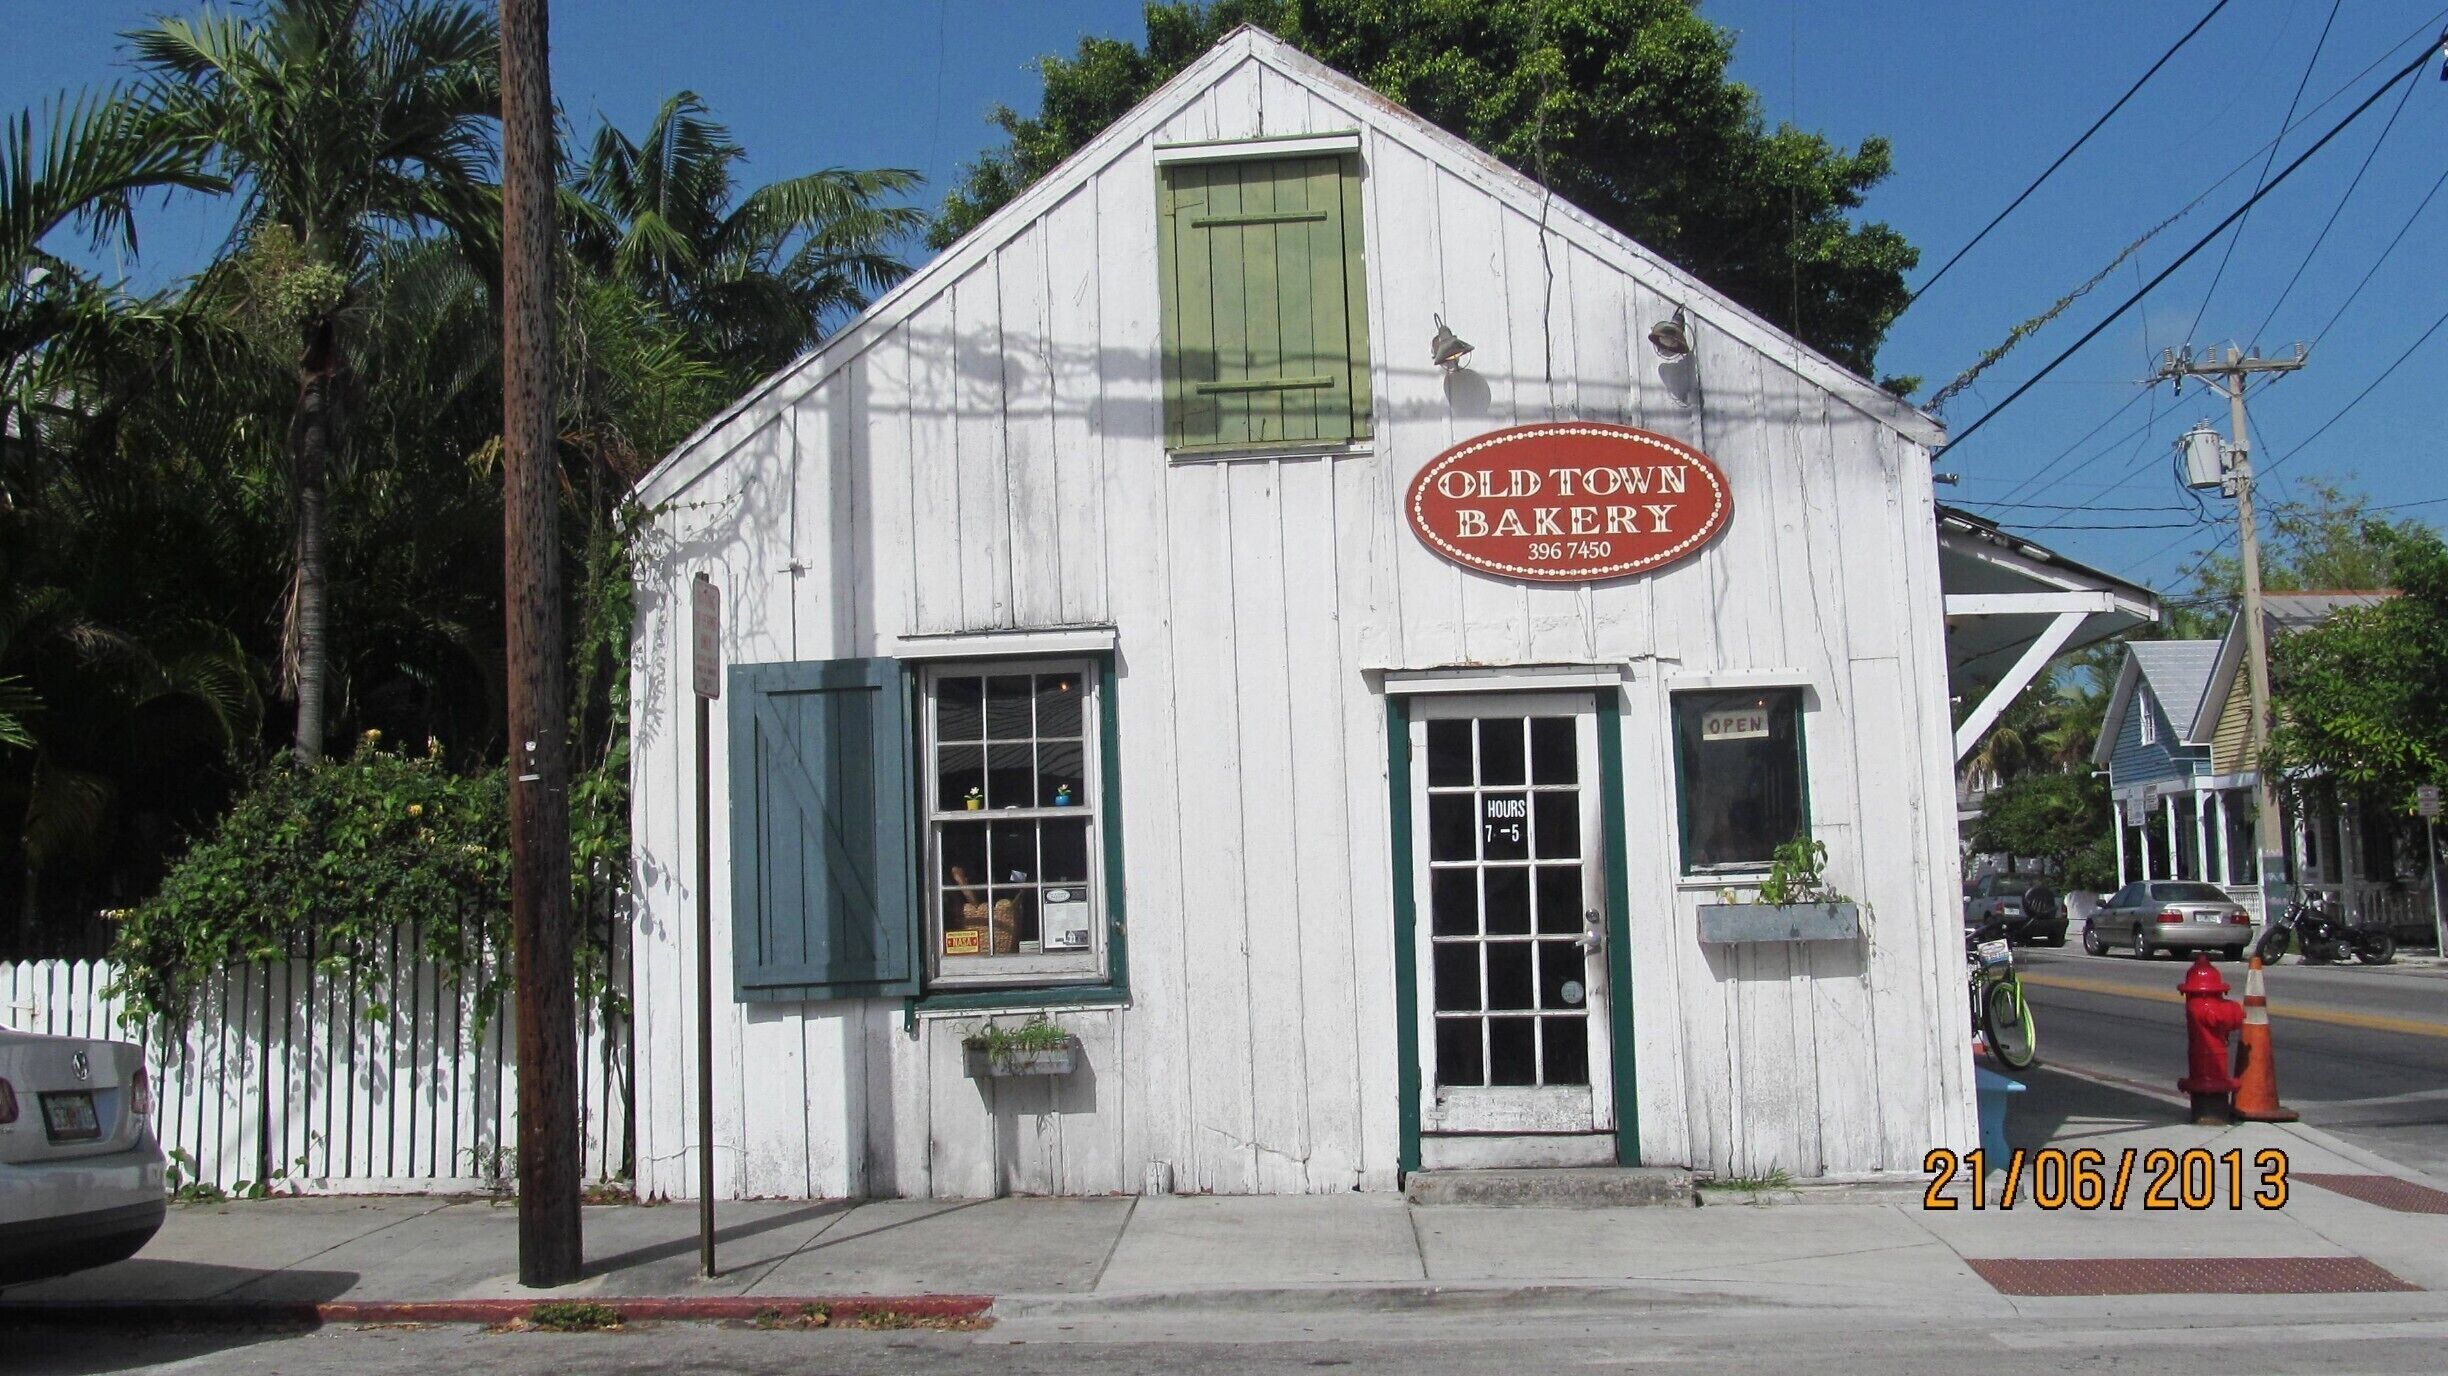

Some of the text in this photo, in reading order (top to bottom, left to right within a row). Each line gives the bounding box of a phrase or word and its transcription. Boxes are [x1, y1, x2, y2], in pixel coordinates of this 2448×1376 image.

[1437, 466, 1687, 499] OLD TOWN
[1456, 504, 1677, 538] BAKERY
[1528, 541, 1611, 561] 396 7450
[1709, 716, 1762, 735] OPEN
[1487, 800, 1526, 818] HOURS
